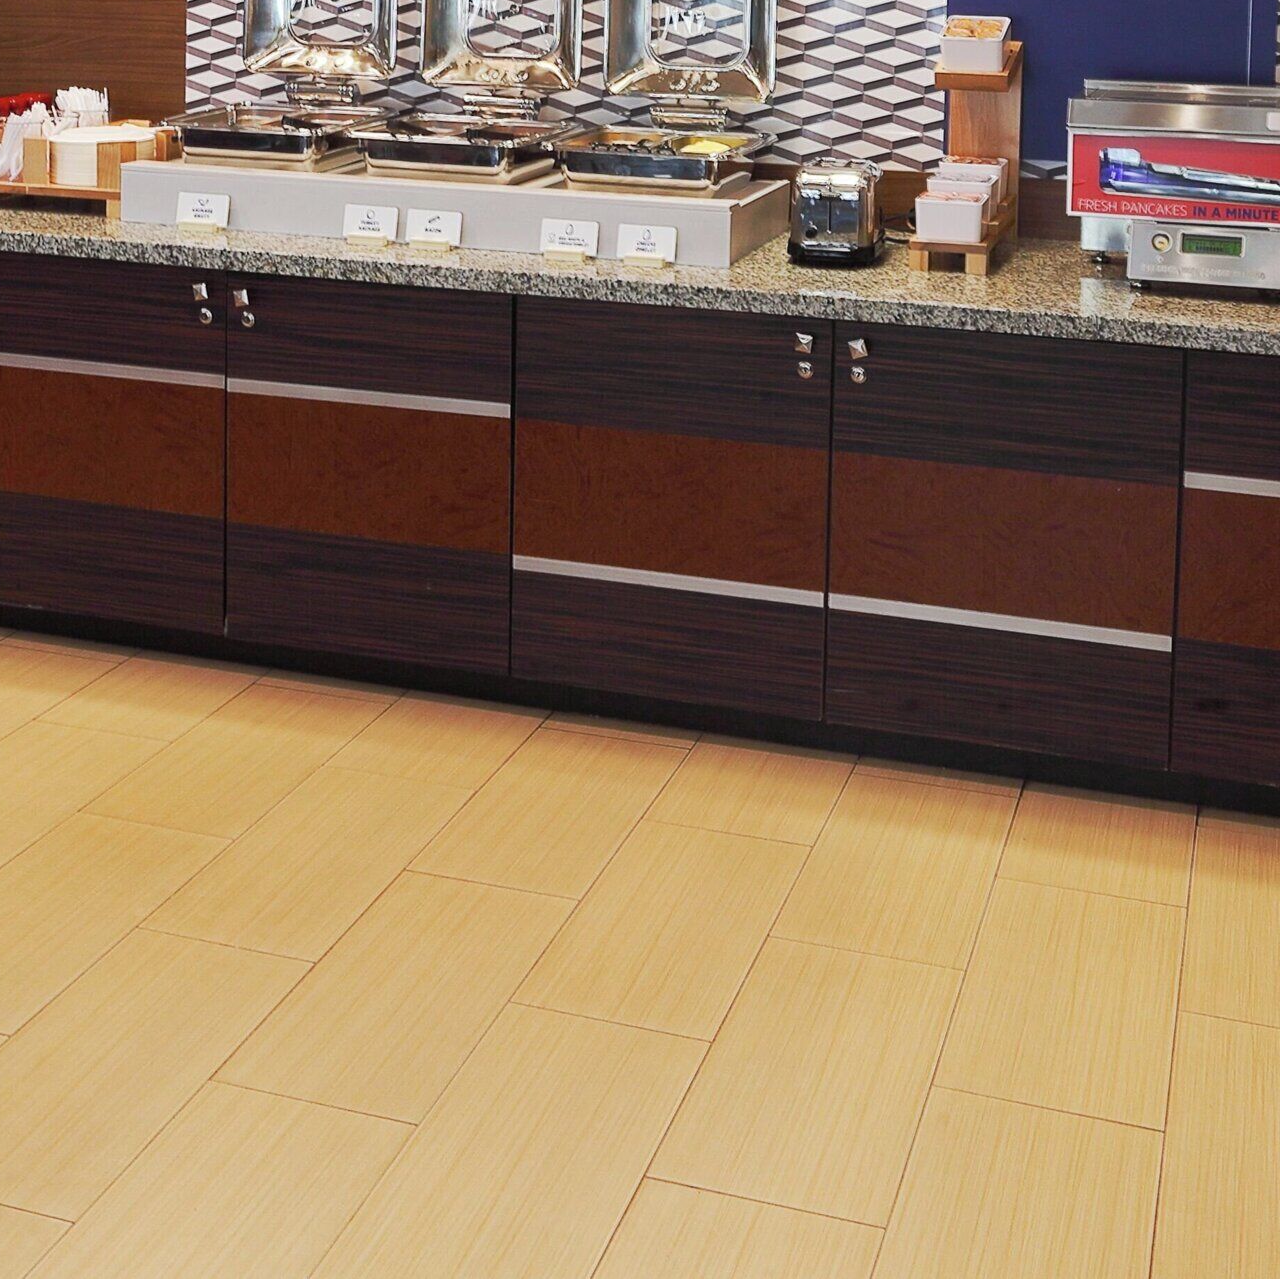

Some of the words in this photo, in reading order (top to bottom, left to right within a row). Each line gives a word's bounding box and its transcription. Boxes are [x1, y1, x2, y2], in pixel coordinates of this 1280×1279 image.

[1078, 199, 1118, 213] FRESH
[1122, 201, 1188, 217] PANCAKES
[1192, 206, 1207, 217] IN
[1212, 207, 1221, 218] A
[1226, 208, 1279, 221] MINUTE
